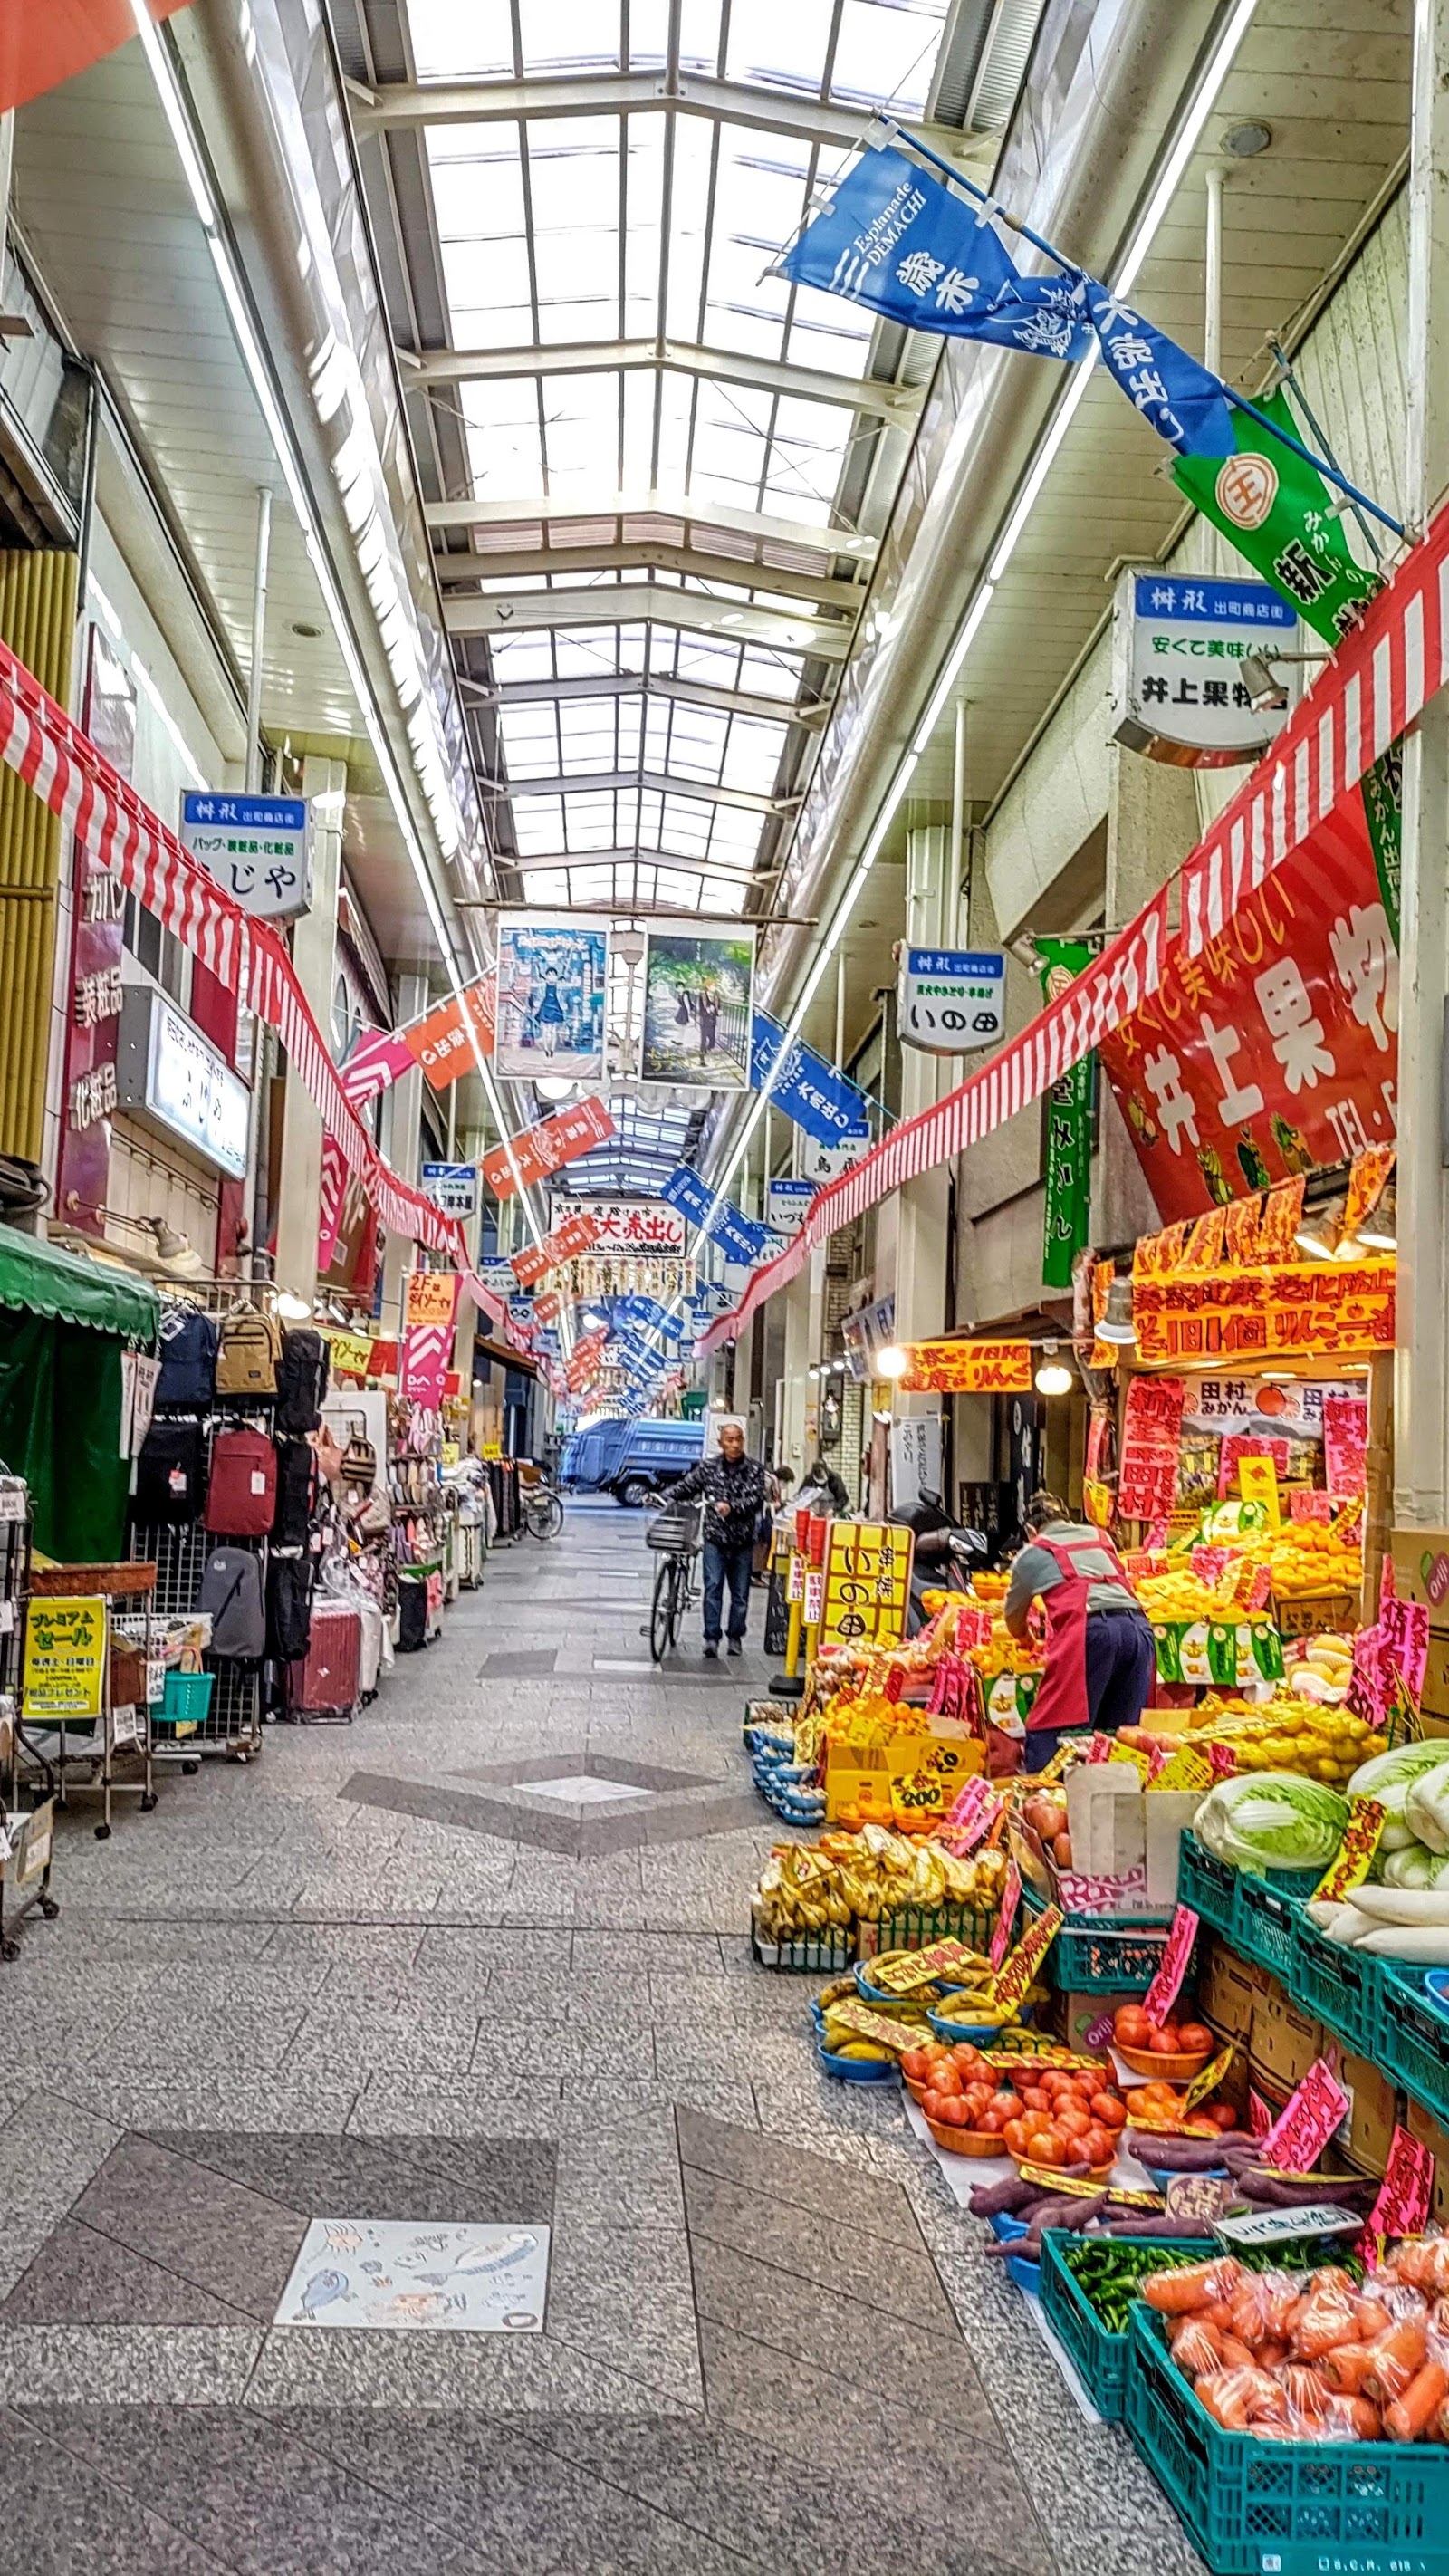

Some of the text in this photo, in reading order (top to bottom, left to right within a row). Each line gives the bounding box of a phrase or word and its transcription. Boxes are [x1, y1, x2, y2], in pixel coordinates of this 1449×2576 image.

[853, 181, 913, 254] Esplanade
[867, 188, 927, 266] DEMACHI
[1214, 600, 1284, 620] 出町商店街
[200, 860, 296, 899] じや
[910, 1004, 999, 1033] いの田
[1201, 1380, 1248, 1401] 田村
[835, 1545, 872, 1637] いの田
[34, 1627, 93, 1650] セール
